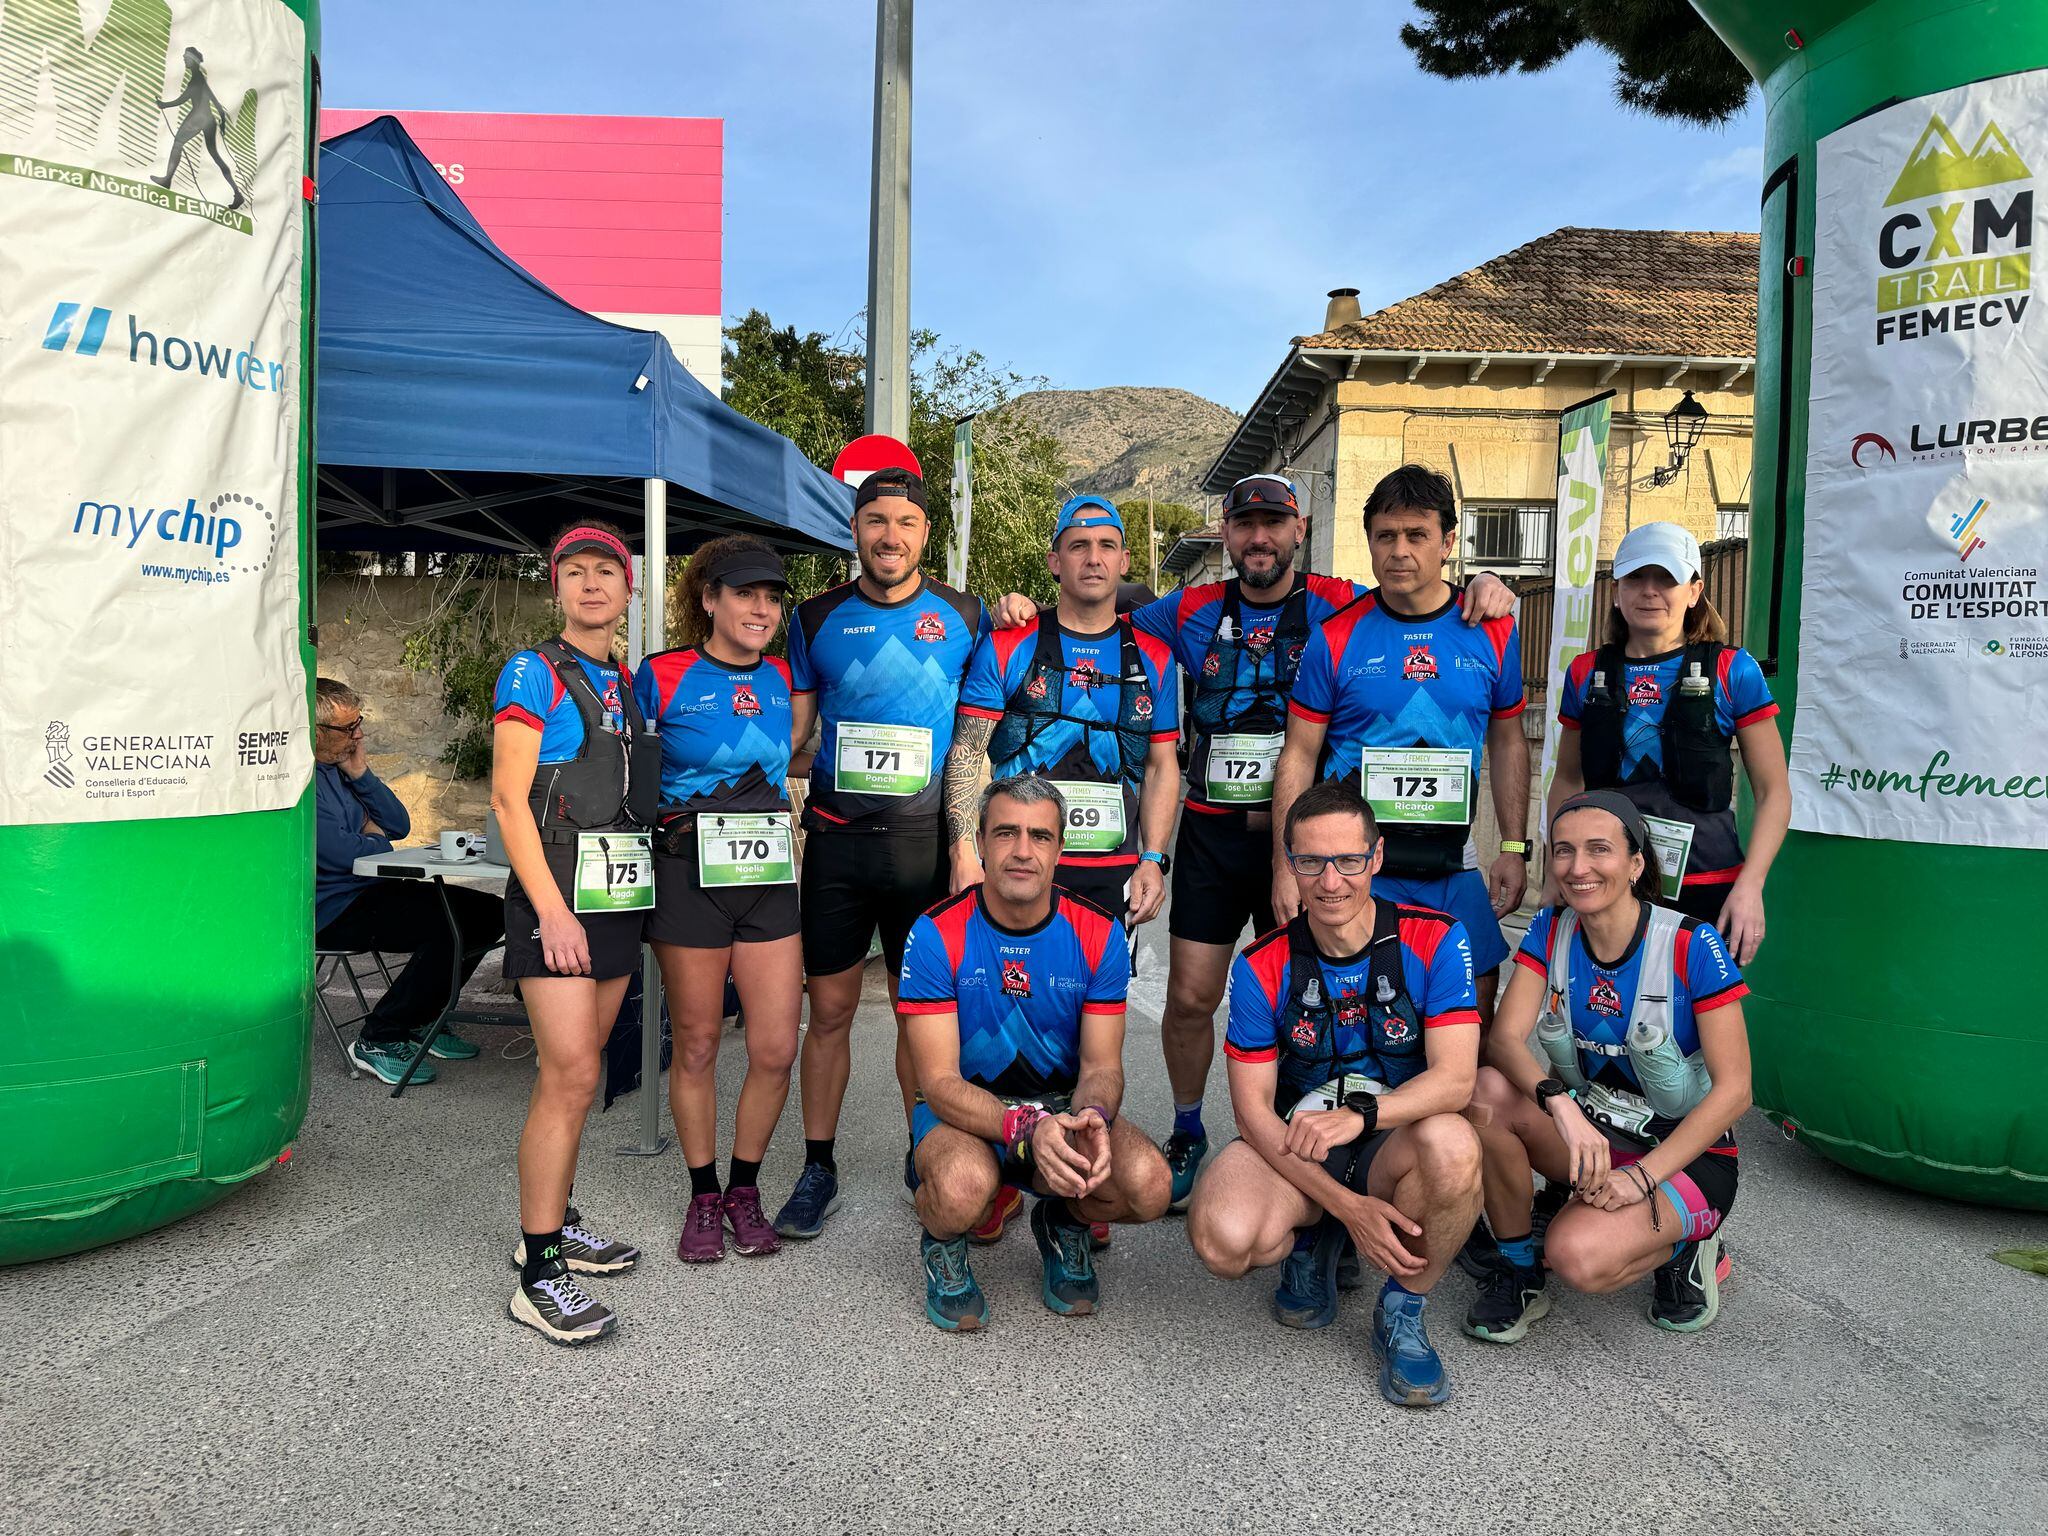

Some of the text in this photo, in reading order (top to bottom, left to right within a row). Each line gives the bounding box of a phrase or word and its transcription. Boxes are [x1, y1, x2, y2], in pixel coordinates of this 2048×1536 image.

[13, 157, 243, 230] Marxa Nòrdica FEMECV
[1879, 190, 2034, 269] CXM
[1889, 261, 2017, 306] TRAIL
[1877, 295, 2030, 346] FEMECV
[128, 314, 285, 395] howden
[73, 498, 242, 559] mychip
[142, 563, 230, 585] www.mychip.es
[1904, 566, 2037, 581] Comunitat Valenciana
[1902, 581, 2037, 601] COMUNITAT
[1911, 603, 1940, 619] DE
[843, 625, 876, 634] FASTER
[1404, 632, 1434, 641] FASTER
[1071, 646, 1100, 655] FASTER
[1910, 641, 1957, 649] GENERALITAT
[1629, 665, 1660, 673] FASTER
[83, 735, 214, 752] GENERALITAT
[238, 731, 290, 750] SEMPRE
[86, 754, 212, 771] VALENCIANA
[238, 749, 279, 767] TEUA
[864, 749, 901, 771] 171
[865, 774, 898, 783] Ponchi
[1224, 760, 1261, 780] 172
[1820, 750, 2048, 802] #somfemec
[85, 776, 188, 788] Conselleria d'Educació,
[1224, 783, 1263, 792] Jose Luis
[1393, 776, 1438, 798] 173
[86, 789, 119, 799] Cultura
[127, 788, 156, 799] Esport
[1395, 802, 1435, 811] Ricardo
[727, 839, 770, 860] 170
[607, 862, 638, 885] 175
[735, 864, 765, 873] Noelia
[1000, 946, 1031, 955] FASTER
